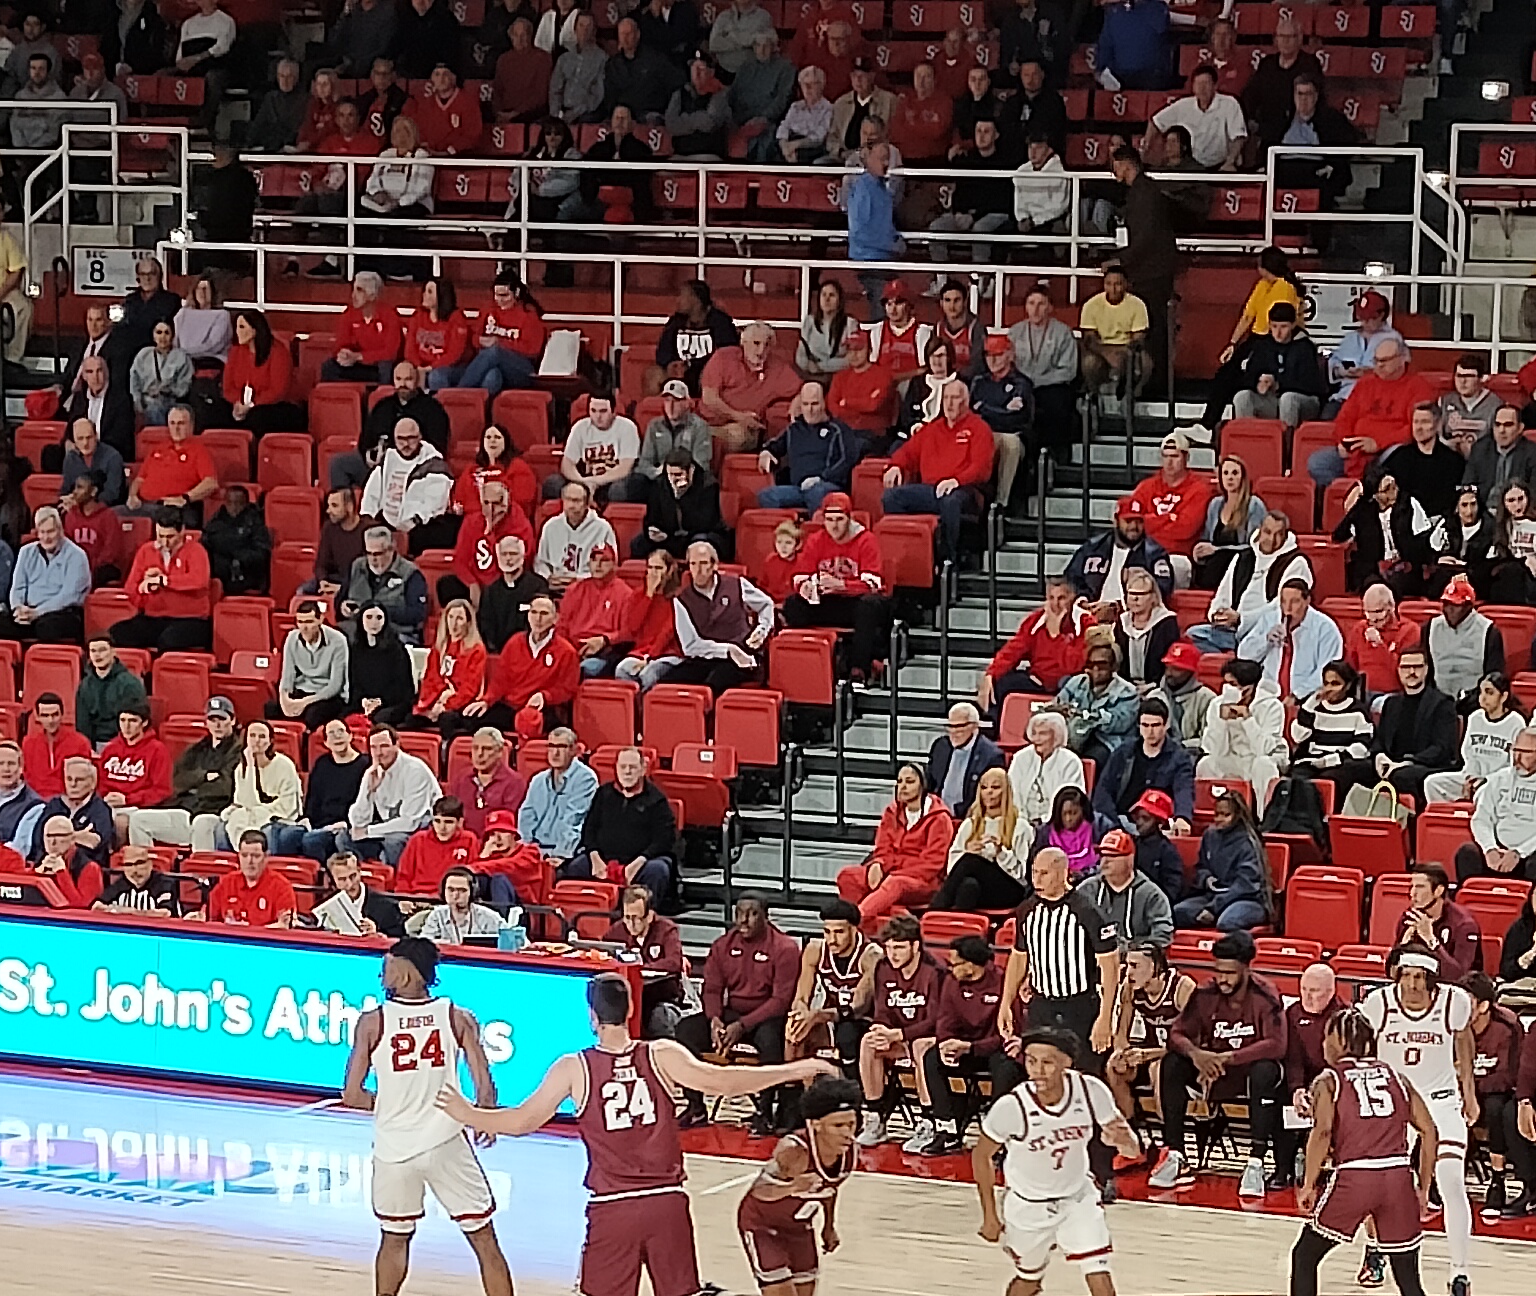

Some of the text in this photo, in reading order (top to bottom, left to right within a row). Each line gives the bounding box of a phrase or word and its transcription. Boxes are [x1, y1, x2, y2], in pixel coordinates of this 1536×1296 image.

[88, 259, 106, 284] 8
[78, 964, 254, 1035] John's
[389, 1029, 446, 1072] 24
[1403, 1047, 1422, 1067] 0
[601, 1078, 657, 1132] 24
[1350, 1076, 1396, 1118] 15
[1051, 1146, 1070, 1171] 7
